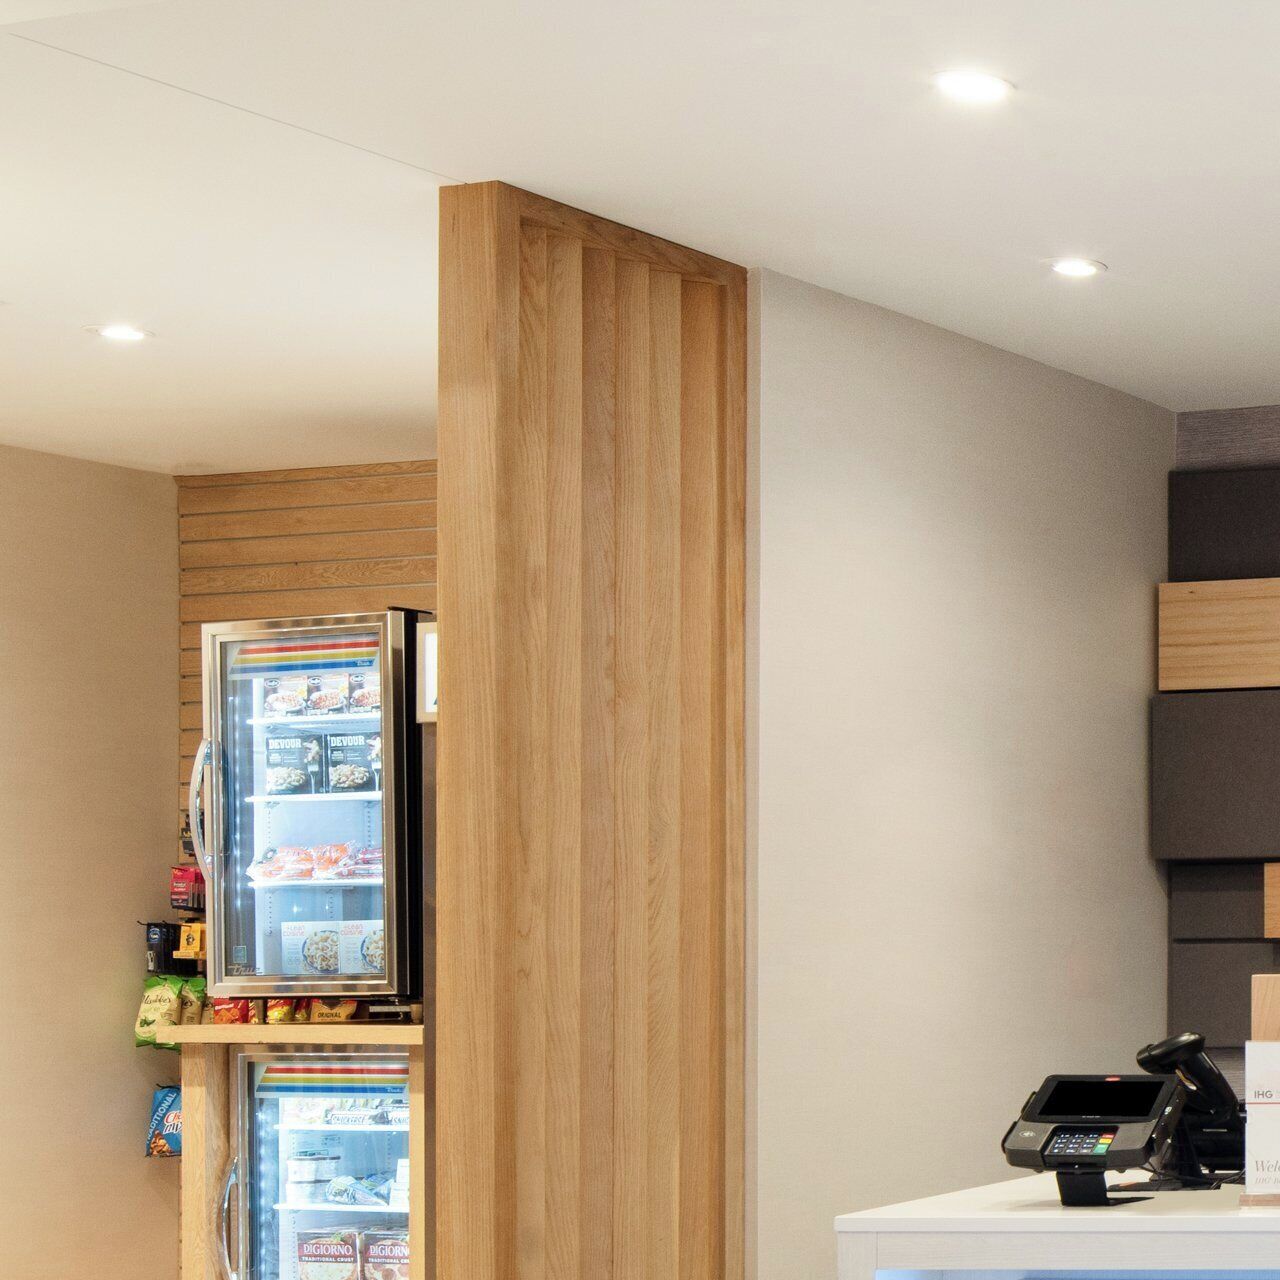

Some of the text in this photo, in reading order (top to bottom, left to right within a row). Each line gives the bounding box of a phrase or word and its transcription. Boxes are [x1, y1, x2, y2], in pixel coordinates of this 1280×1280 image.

[268, 738, 302, 750] DEVOUR
[330, 735, 365, 747] DEVOUR
[1254, 1090, 1273, 1099] IHG
[303, 1243, 353, 1256] DIGIORNO
